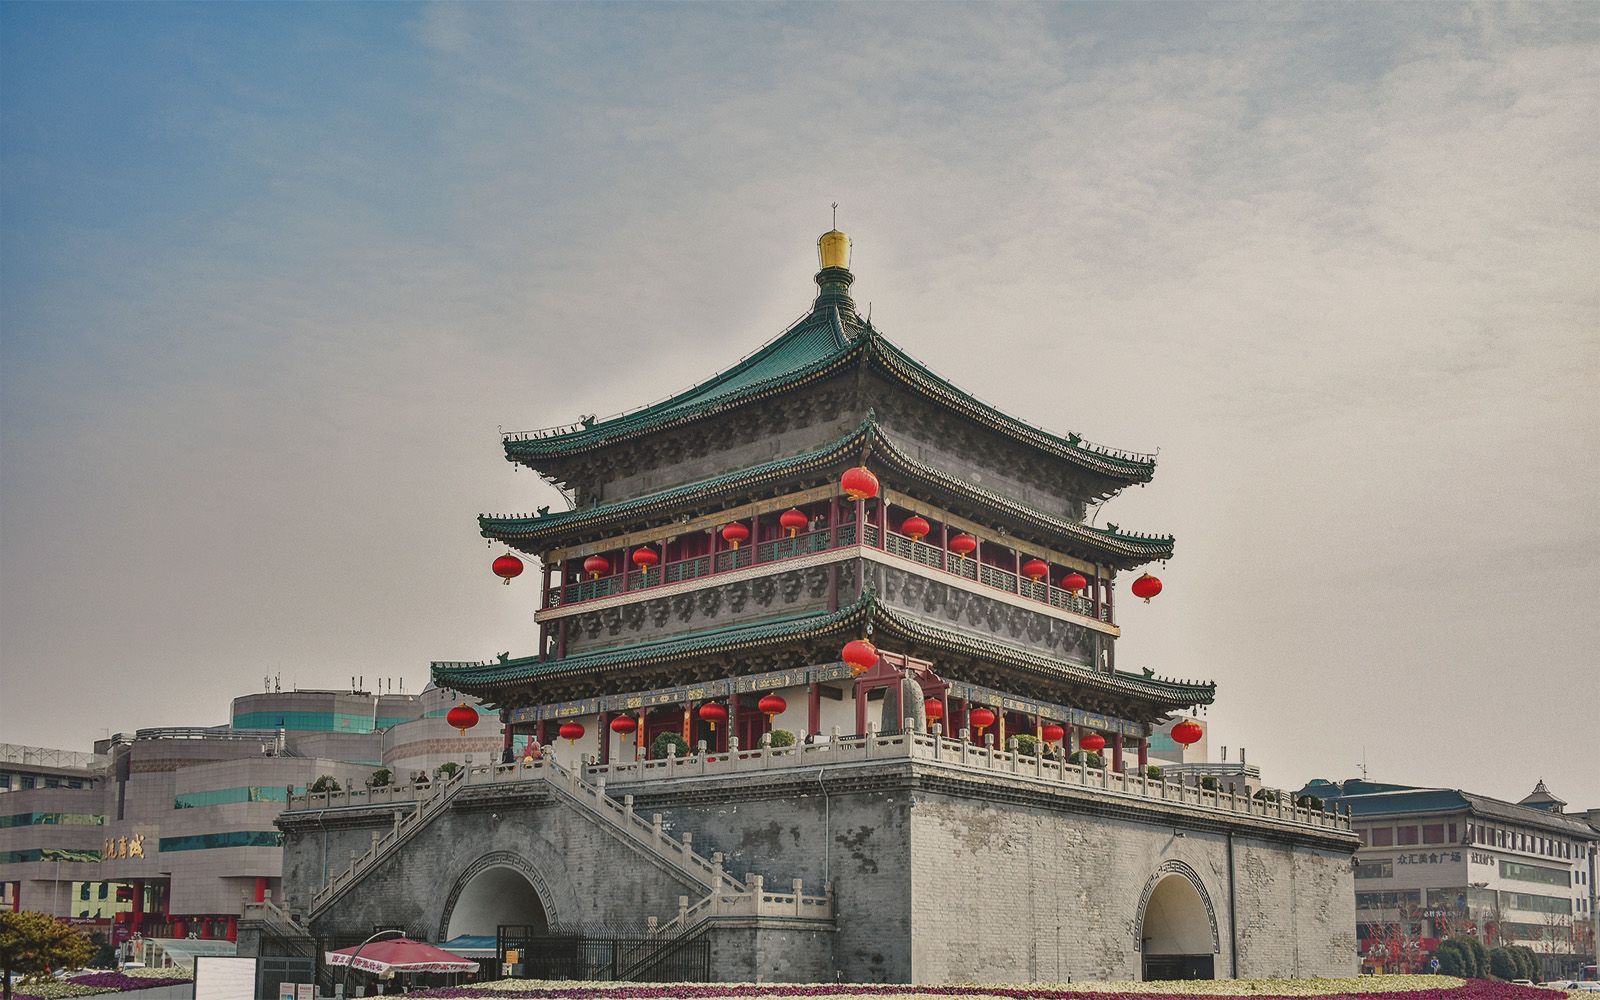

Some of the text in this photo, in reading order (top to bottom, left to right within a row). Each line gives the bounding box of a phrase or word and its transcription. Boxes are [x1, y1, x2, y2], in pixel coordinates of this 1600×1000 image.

[1397, 851, 1461, 864] 众汇美食广场
